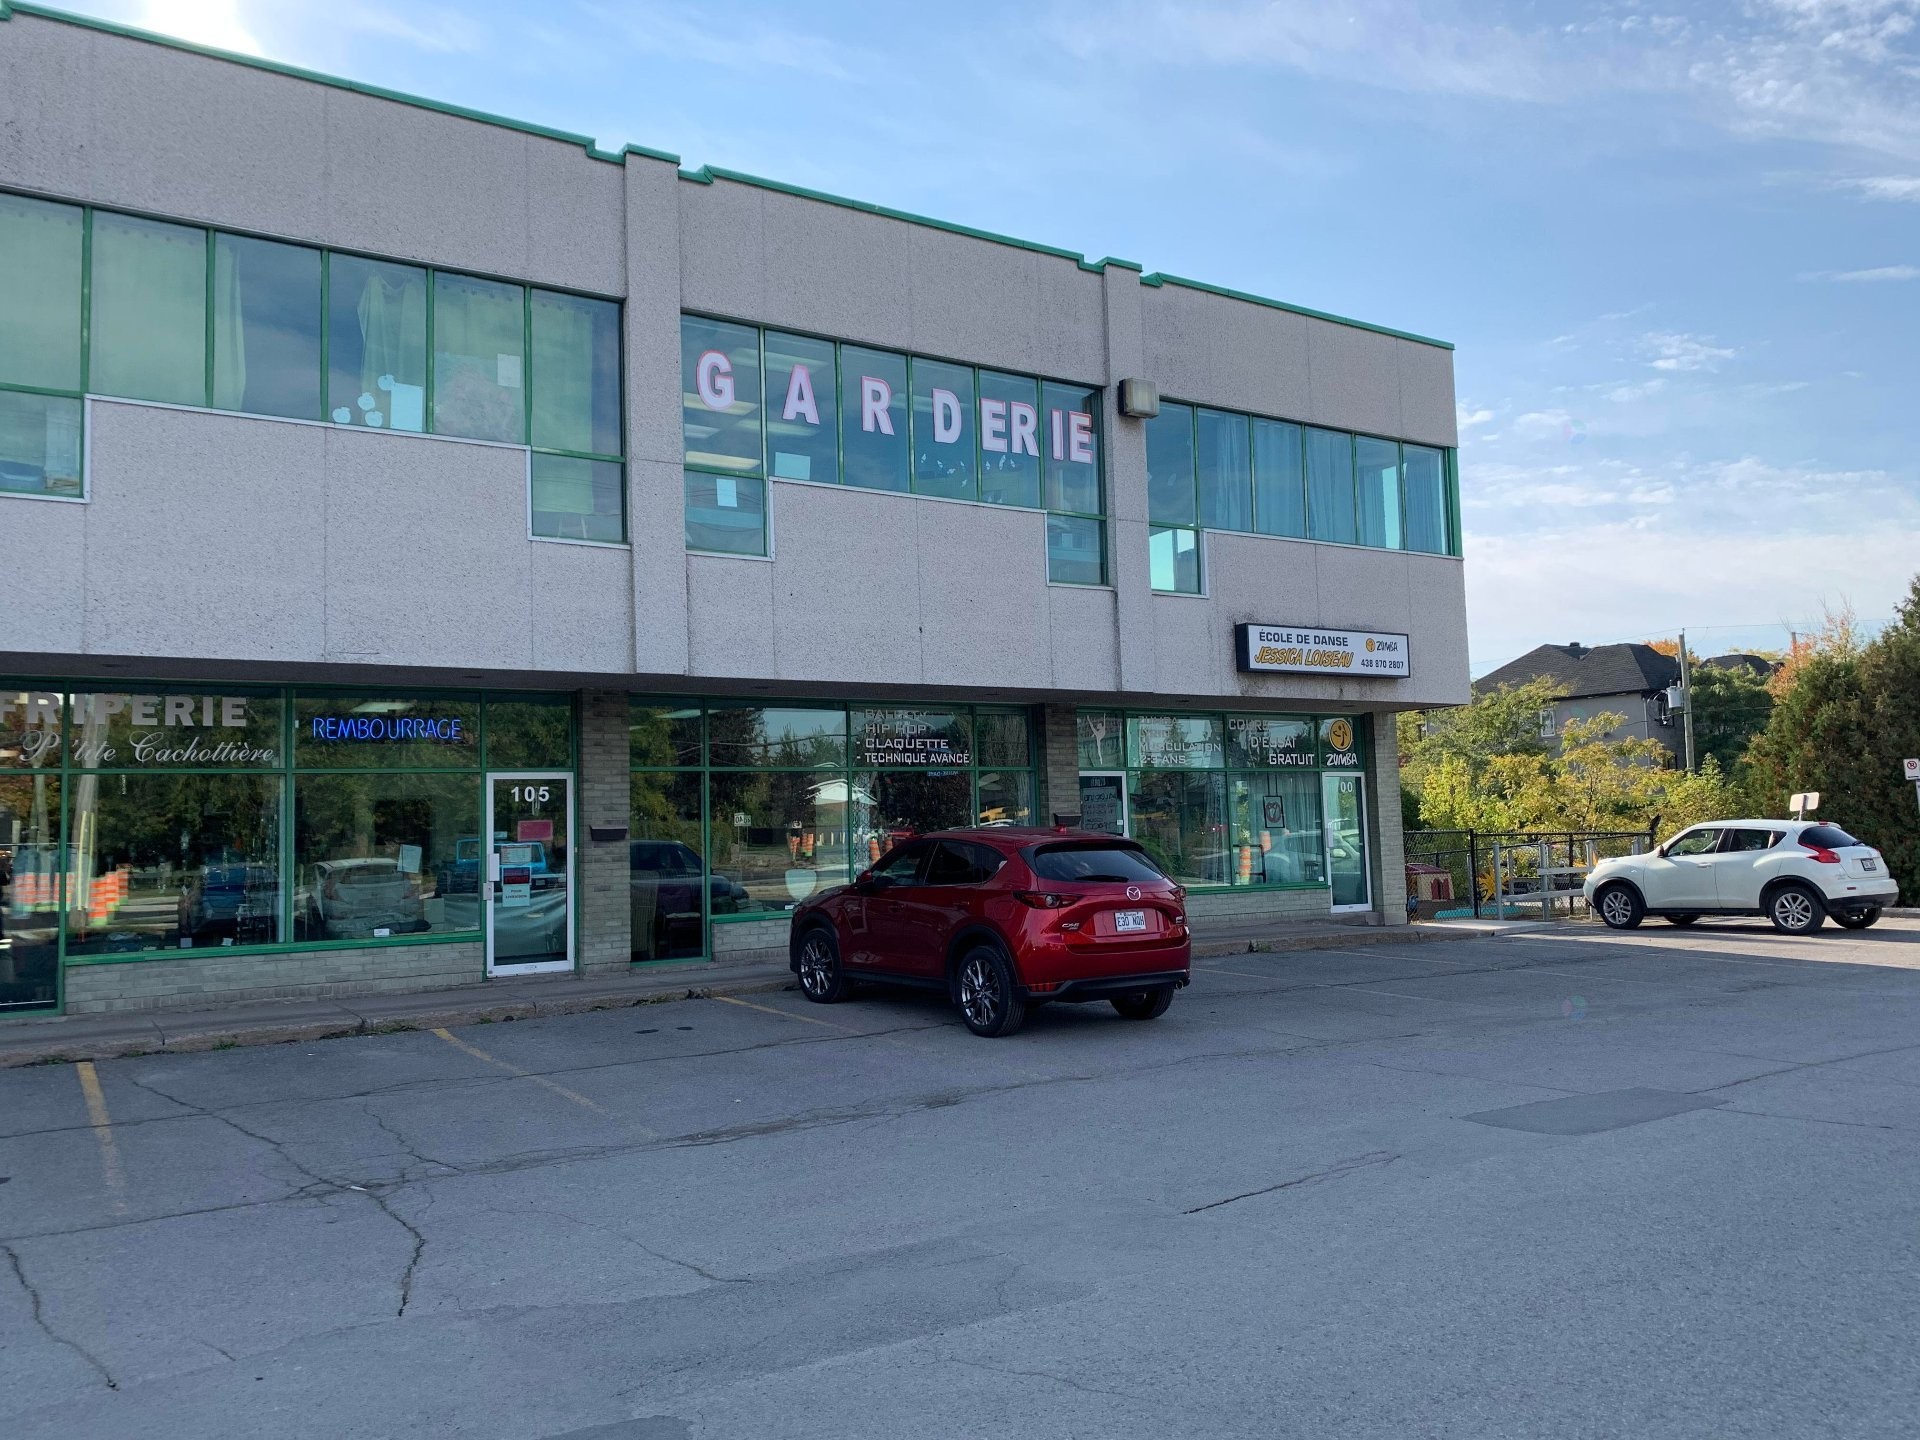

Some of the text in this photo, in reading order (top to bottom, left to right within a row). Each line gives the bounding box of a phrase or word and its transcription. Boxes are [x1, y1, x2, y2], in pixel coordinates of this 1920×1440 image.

[696, 349, 1094, 464] GARDERIE
[1259, 628, 1349, 647] ÉCOLE DE DANSE
[1376, 640, 1399, 652] ZUMBA
[1254, 646, 1354, 668] JESSICA LOISEAU
[1388, 660, 1404, 670] 2807
[313, 717, 462, 739] REMBOURRAGE
[865, 723, 926, 734] HIP HOP
[129, 730, 274, 763] Cachottière
[865, 738, 949, 750] CLAQUETTE
[864, 749, 970, 765] TECHNIQUE AVANCÉ
[1162, 755, 1186, 764] ANS
[1269, 753, 1315, 765] GRATUIT
[1326, 752, 1358, 767] ZUMBA
[510, 786, 550, 803] 105
